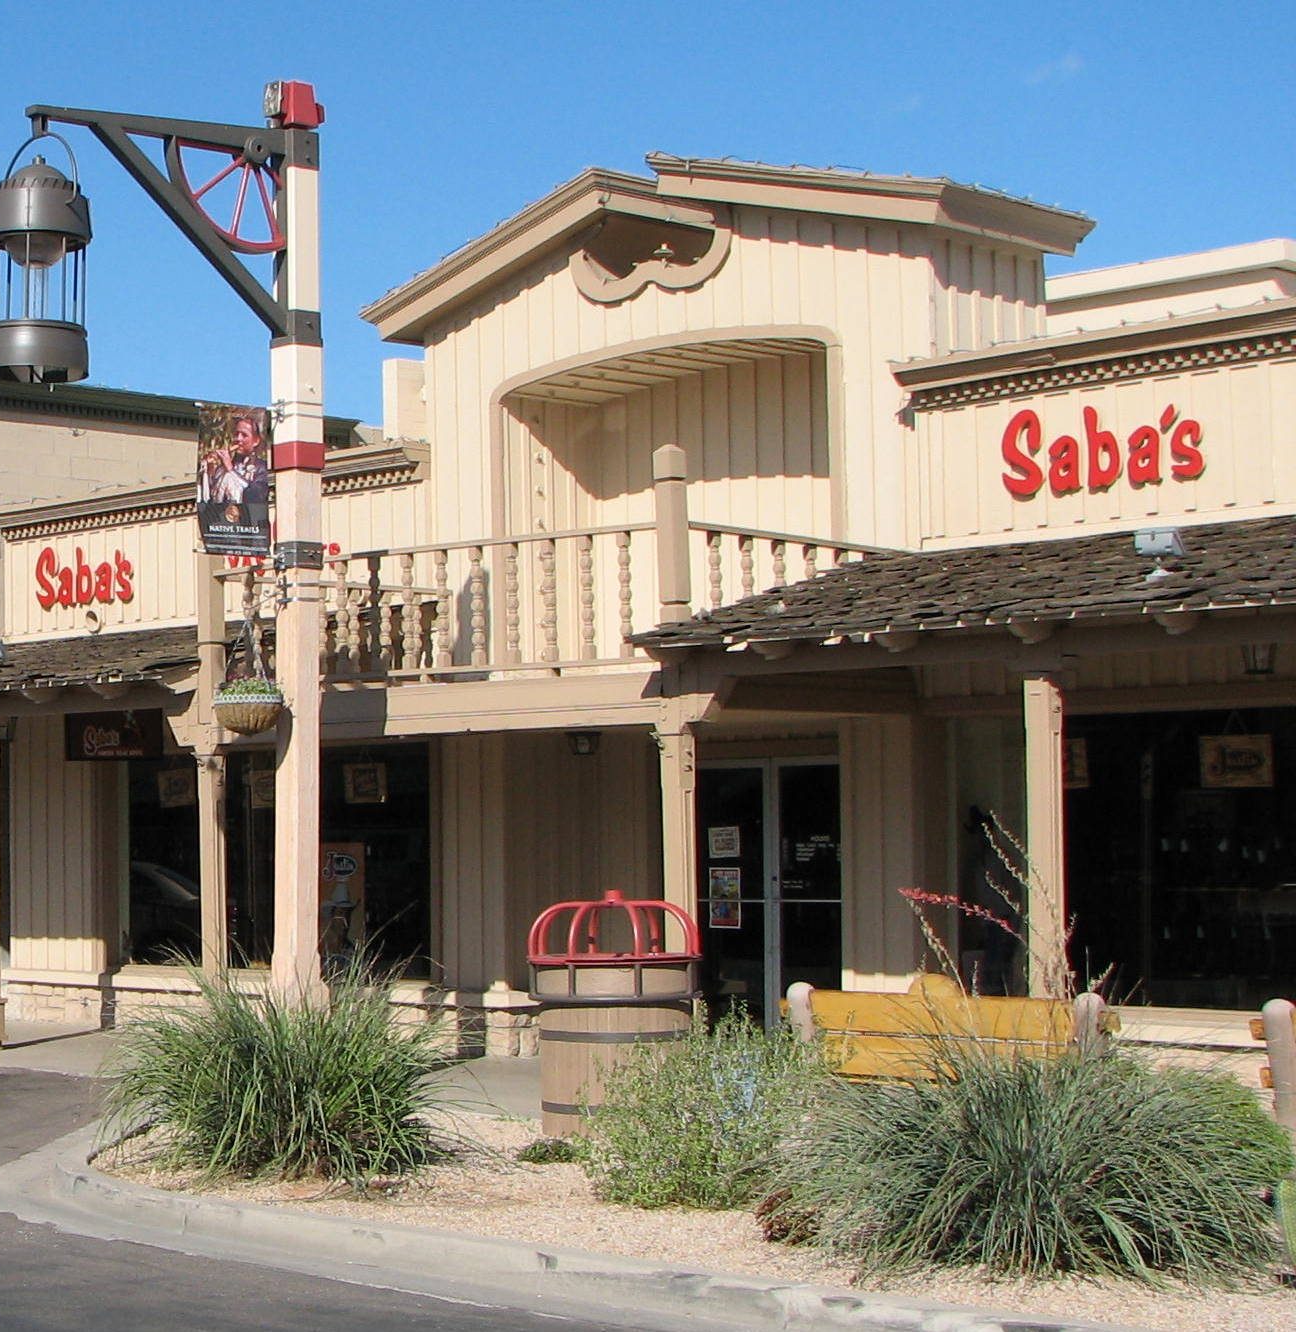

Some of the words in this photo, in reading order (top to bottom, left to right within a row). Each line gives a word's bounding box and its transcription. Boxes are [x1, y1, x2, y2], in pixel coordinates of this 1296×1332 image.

[1001, 403, 1204, 498] Saba's
[209, 525, 235, 533] NATIVE
[236, 525, 260, 534] TRAILS
[35, 546, 133, 611] Saba's
